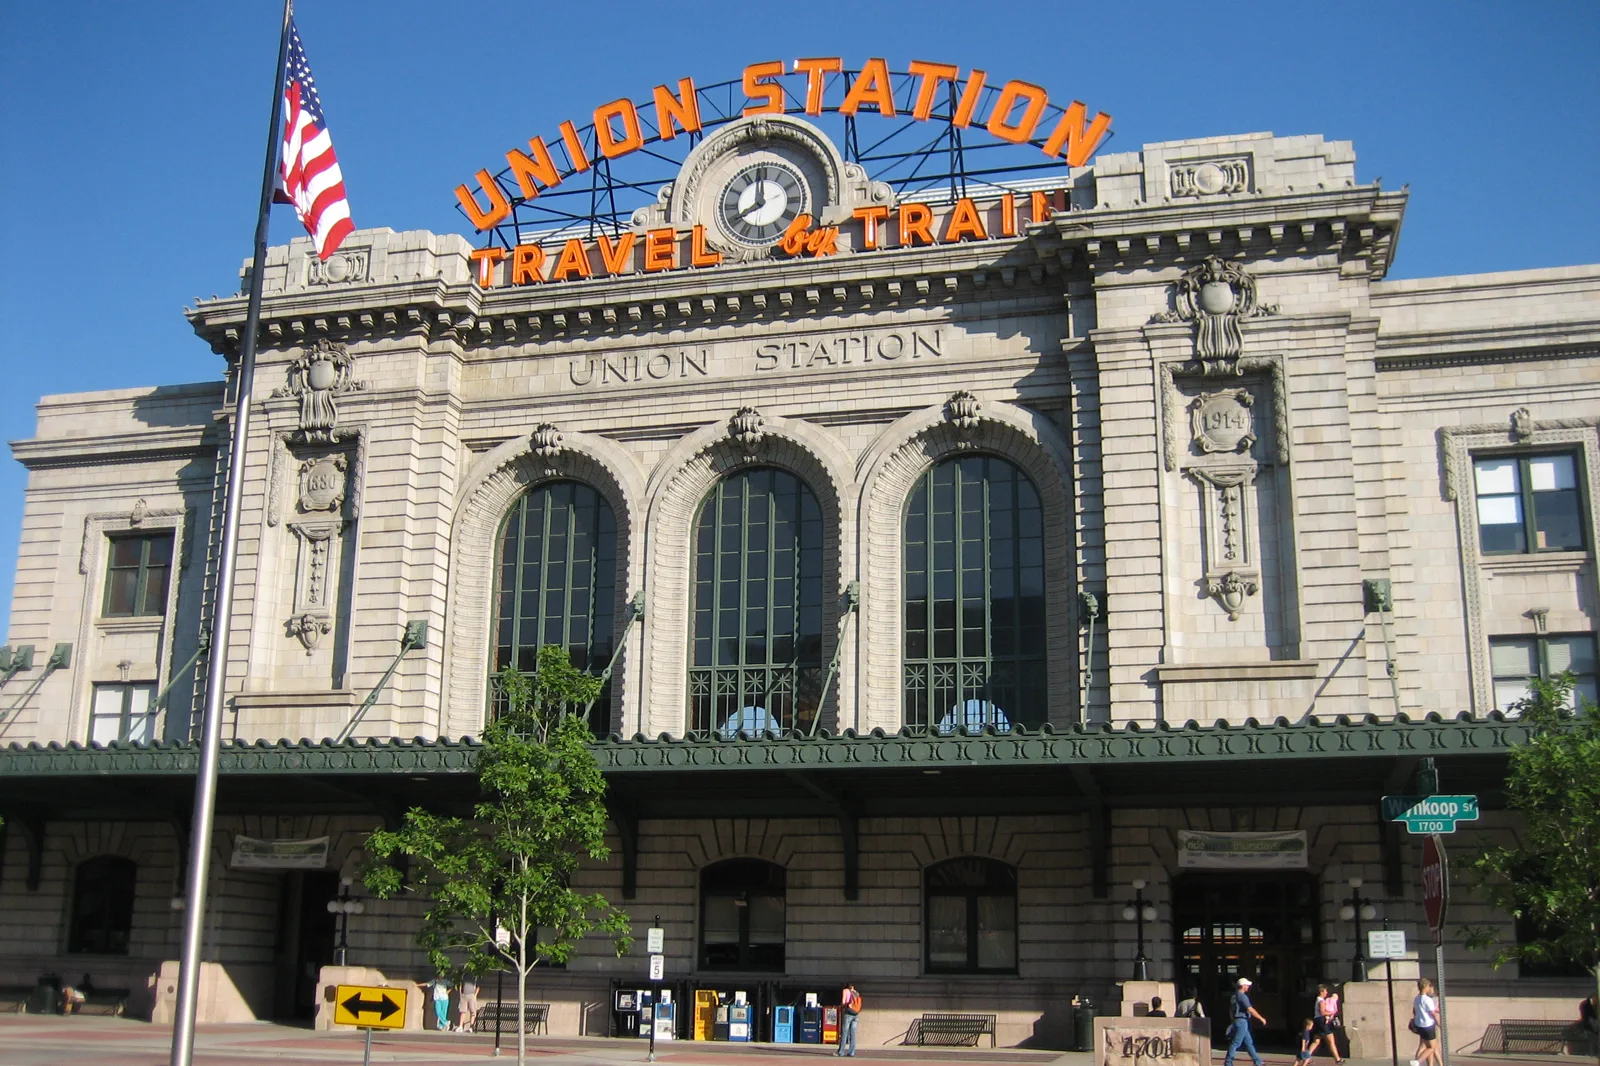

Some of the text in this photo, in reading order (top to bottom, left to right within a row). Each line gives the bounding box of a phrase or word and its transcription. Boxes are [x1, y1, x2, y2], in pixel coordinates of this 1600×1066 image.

[454, 57, 1112, 231] UNION STATION
[469, 223, 725, 289] TRAVEL
[777, 213, 840, 258] by
[569, 329, 944, 387] UNION STATION
[1203, 410, 1245, 431] 1914
[307, 474, 337, 492] 1880
[1387, 799, 1459, 818] Wynkoop
[1418, 821, 1444, 831] 1700
[1422, 862, 1441, 900] STOP
[653, 965, 660, 975] 5
[1121, 1036, 1174, 1059] 1701
